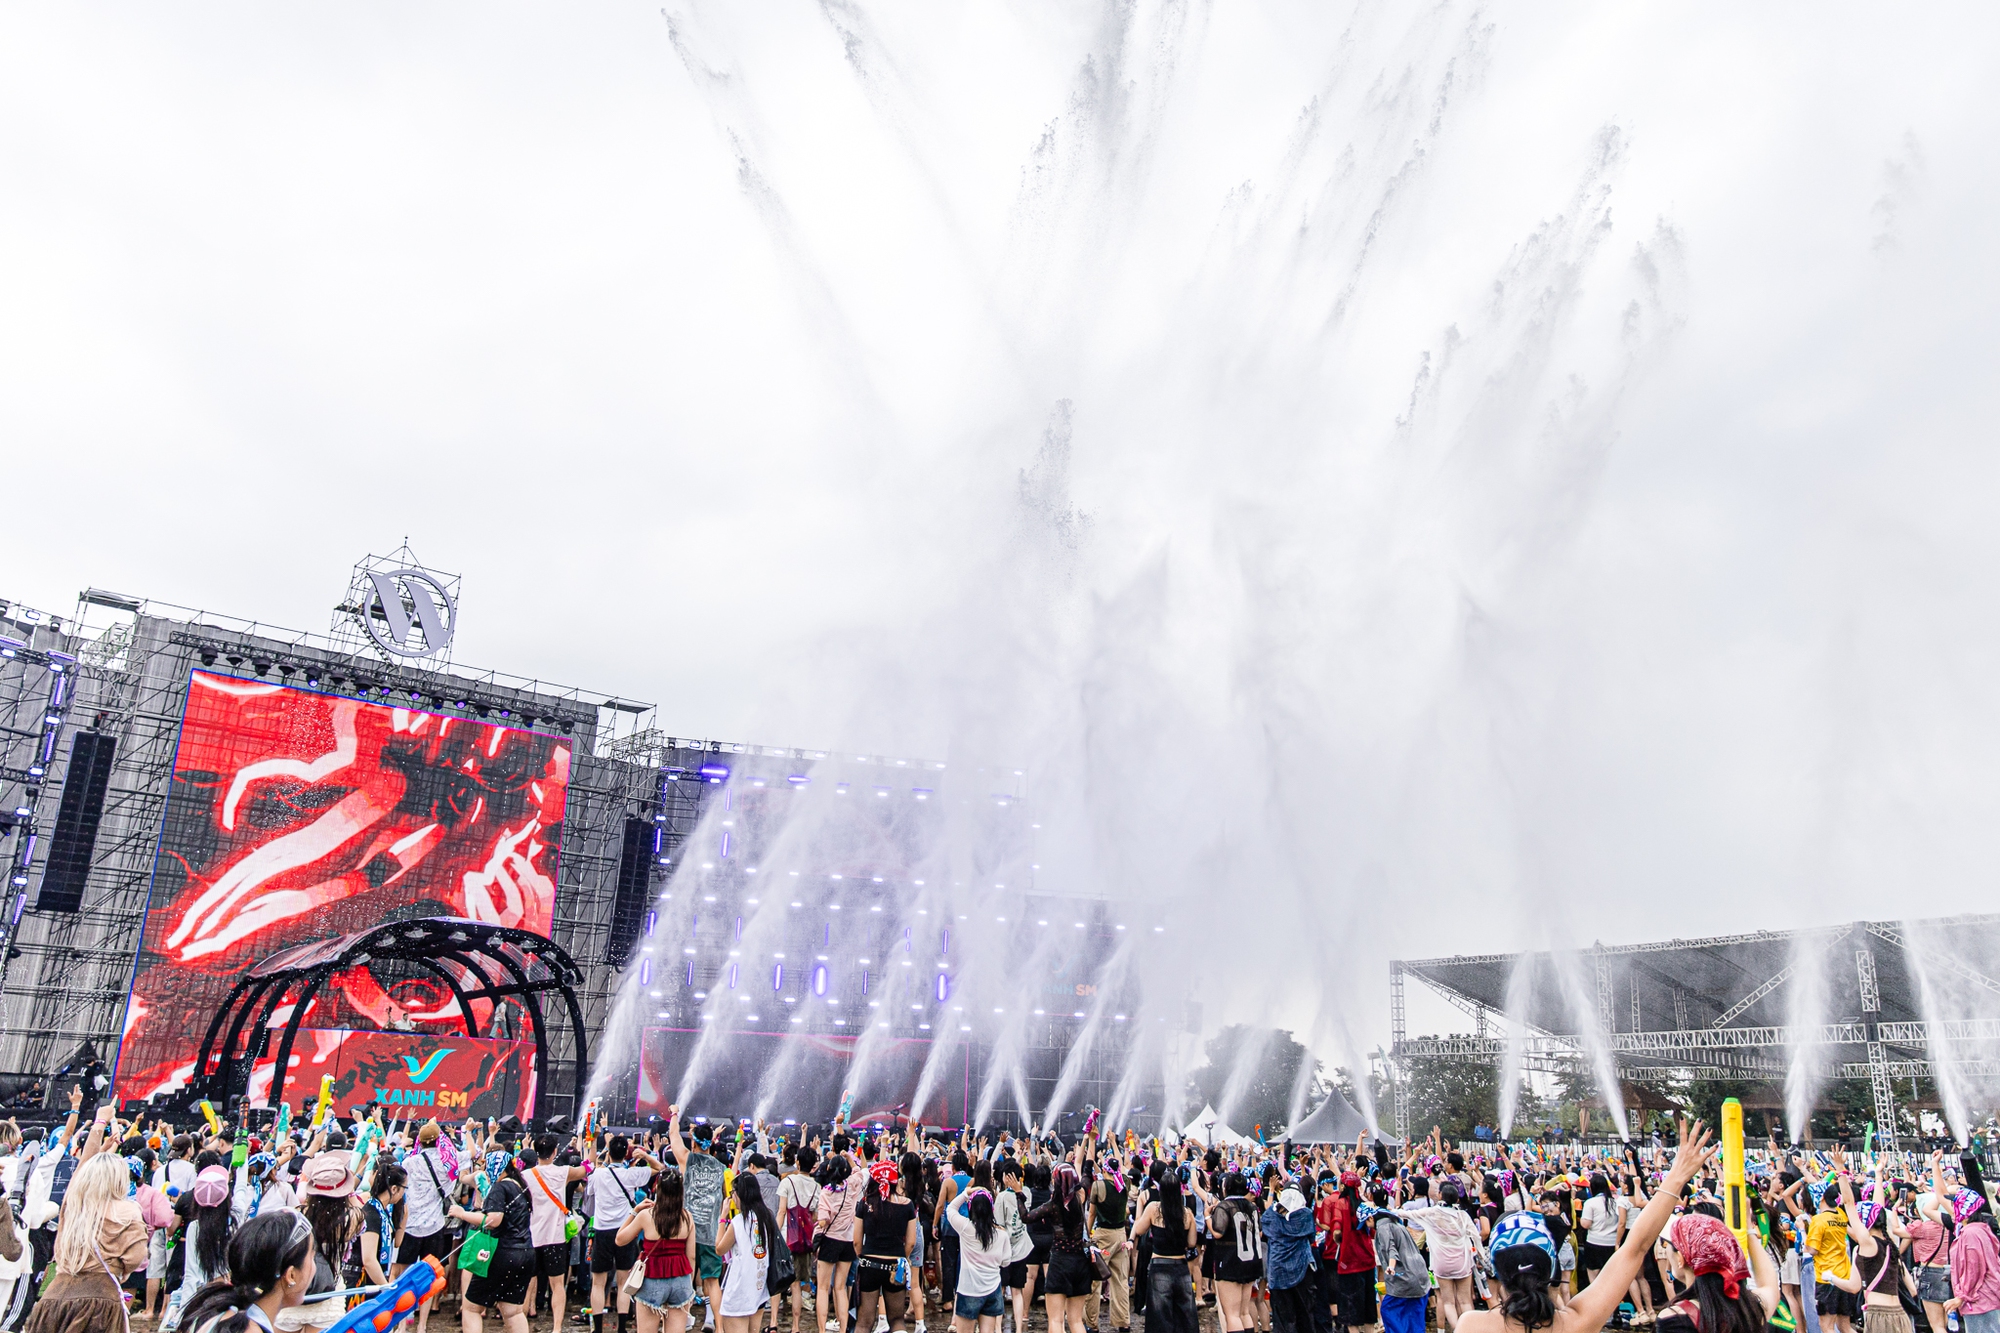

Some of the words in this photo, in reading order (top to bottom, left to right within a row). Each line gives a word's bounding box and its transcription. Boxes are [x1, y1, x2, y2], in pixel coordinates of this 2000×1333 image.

[1075, 984, 1097, 997] SM
[374, 1087, 435, 1107] XANH
[437, 1090, 467, 1108] SM
